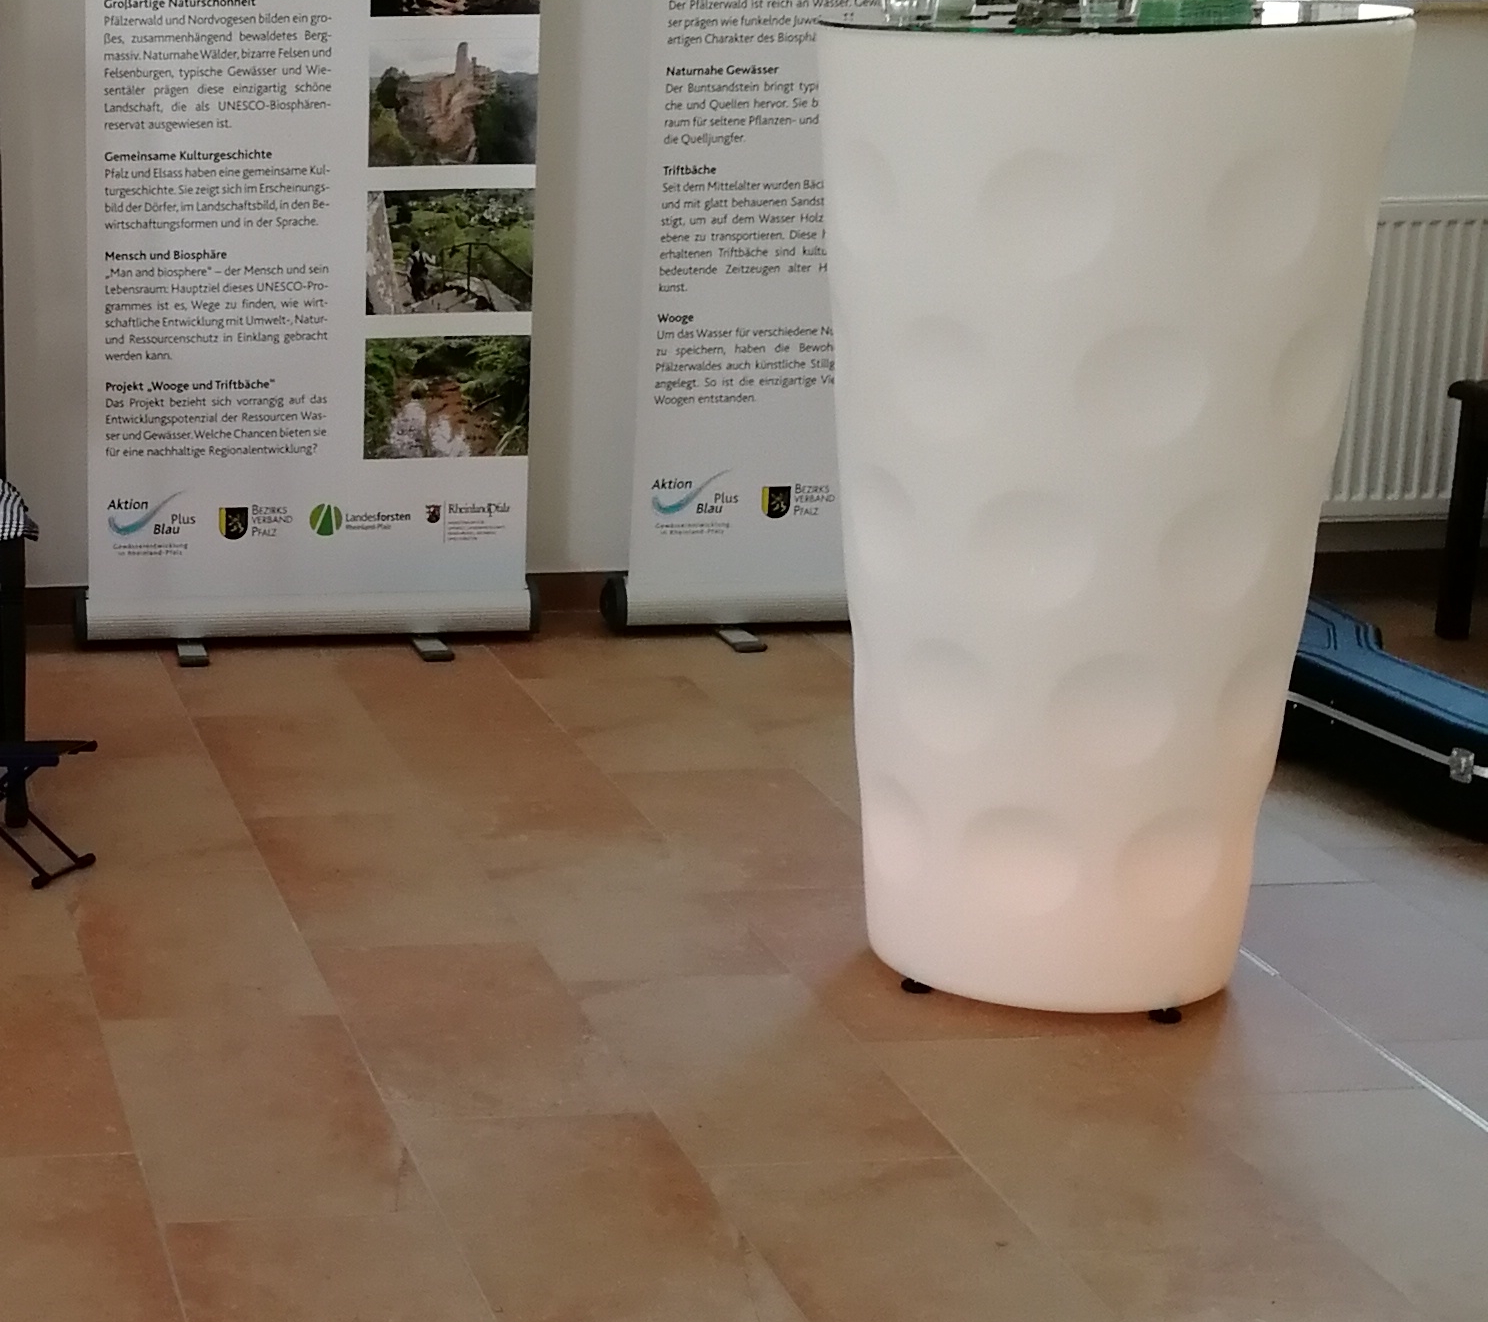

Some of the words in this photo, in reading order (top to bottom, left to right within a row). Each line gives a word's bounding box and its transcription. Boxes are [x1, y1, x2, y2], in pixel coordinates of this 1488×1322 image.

[104, 14, 162, 26] Pfälzerwald
[165, 14, 186, 25] und
[188, 13, 256, 27] Nordvogesen
[258, 12, 290, 23] bilden
[292, 12, 308, 23] ein
[309, 14, 332, 25] gro-
[131, 31, 233, 46] zusammenhängend
[239, 30, 298, 41] bewaldetes
[304, 30, 332, 43] Berg-
[104, 49, 141, 60] massiv.
[143, 49, 199, 60] Naturnahe
[200, 48, 240, 62] Wälder,
[241, 47, 276, 59] bizarre
[278, 47, 310, 58] Felsen
[312, 47, 332, 58] und
[104, 66, 174, 80] Felsenburgen,
[179, 65, 223, 79] typische
[227, 64, 277, 76] Gewässer
[282, 64, 302, 75] und
[305, 63, 332, 74] Wie-
[666, 65, 724, 76] Naturnahe
[726, 64, 779, 75] Gewässer
[104, 84, 146, 95] sentäler
[153, 83, 189, 97] prägen
[197, 83, 225, 94] diese
[232, 82, 287, 96] einzigartig
[295, 81, 332, 92] schöne
[104, 101, 163, 115] Landschaft,
[171, 100, 187, 111] die
[195, 100, 210, 111] als
[218, 98, 331, 113] UNESCO-Biosphären-
[665, 100, 683, 110] che
[686, 99, 706, 110] und
[709, 98, 749, 112] Quellen
[753, 98, 788, 109] hervor.
[792, 97, 808, 108] Sie
[104, 118, 146, 130] reservat
[148, 117, 214, 132] ausgewiesen
[216, 117, 232, 128] ist.
[664, 119, 690, 127] raum
[692, 116, 707, 127] für
[748, 115, 797, 126] Pflanzen-
[799, 114, 819, 125] und
[664, 134, 678, 144] die
[104, 149, 176, 161] Gemeinsame
[179, 148, 273, 163] Kulturgeschichte
[104, 167, 129, 178] Pfalz
[131, 167, 151, 178] und
[153, 167, 183, 178] Elsass
[184, 166, 217, 177] haben
[218, 166, 239, 177] eine
[242, 165, 308, 179] gemeinsame
[309, 165, 330, 175] Kul-
[663, 164, 717, 176] Triftbäche
[178, 184, 194, 195] Sie
[195, 183, 220, 197] zeigt
[221, 183, 242, 194] sich
[244, 183, 258, 194] im
[259, 182, 330, 196] Erscheinungs-
[104, 201, 124, 212] bild
[125, 201, 142, 212] der
[144, 200, 179, 214] Dörfer,
[181, 200, 194, 211] im
[279, 199, 289, 209] in
[291, 198, 310, 209] den
[312, 198, 330, 209] Be-
[104, 217, 218, 232] wirtschaftungsformen
[220, 217, 241, 228] und
[243, 216, 253, 227] in
[256, 216, 273, 227] der
[275, 215, 319, 230] Sprache.
[689, 217, 706, 225] um
[711, 214, 728, 225] auf
[732, 214, 754, 225] dem
[759, 213, 795, 224] Wasser
[800, 212, 824, 223] Holz
[104, 249, 146, 261] Mensch
[149, 249, 171, 260] und
[173, 248, 228, 262] Biosphäre
[657, 312, 694, 326] Wooge
[656, 347, 667, 355] zu
[734, 342, 766, 354] haben
[774, 342, 790, 353] die
[655, 360, 722, 371] Pfälzerwaldes
[726, 359, 751, 370] auch
[755, 358, 806, 369] künstliche
[105, 380, 144, 394] Projekt
[147, 379, 189, 393] „Wooge
[192, 379, 212, 390] und
[215, 377, 275, 389] Triftbäche“
[654, 393, 695, 408] Woogen
[105, 446, 121, 457] für
[123, 446, 144, 456] eine
[146, 445, 206, 459] nachhaltige
[209, 443, 318, 458] Regionalentwicklung?
[652, 479, 692, 490] Aktion
[107, 499, 149, 511] Aktion
[714, 492, 739, 504] Plus
[696, 503, 723, 514] Blau
[171, 513, 196, 525] Plus
[345, 511, 411, 522] Landesforsten
[153, 524, 180, 535] Blau
